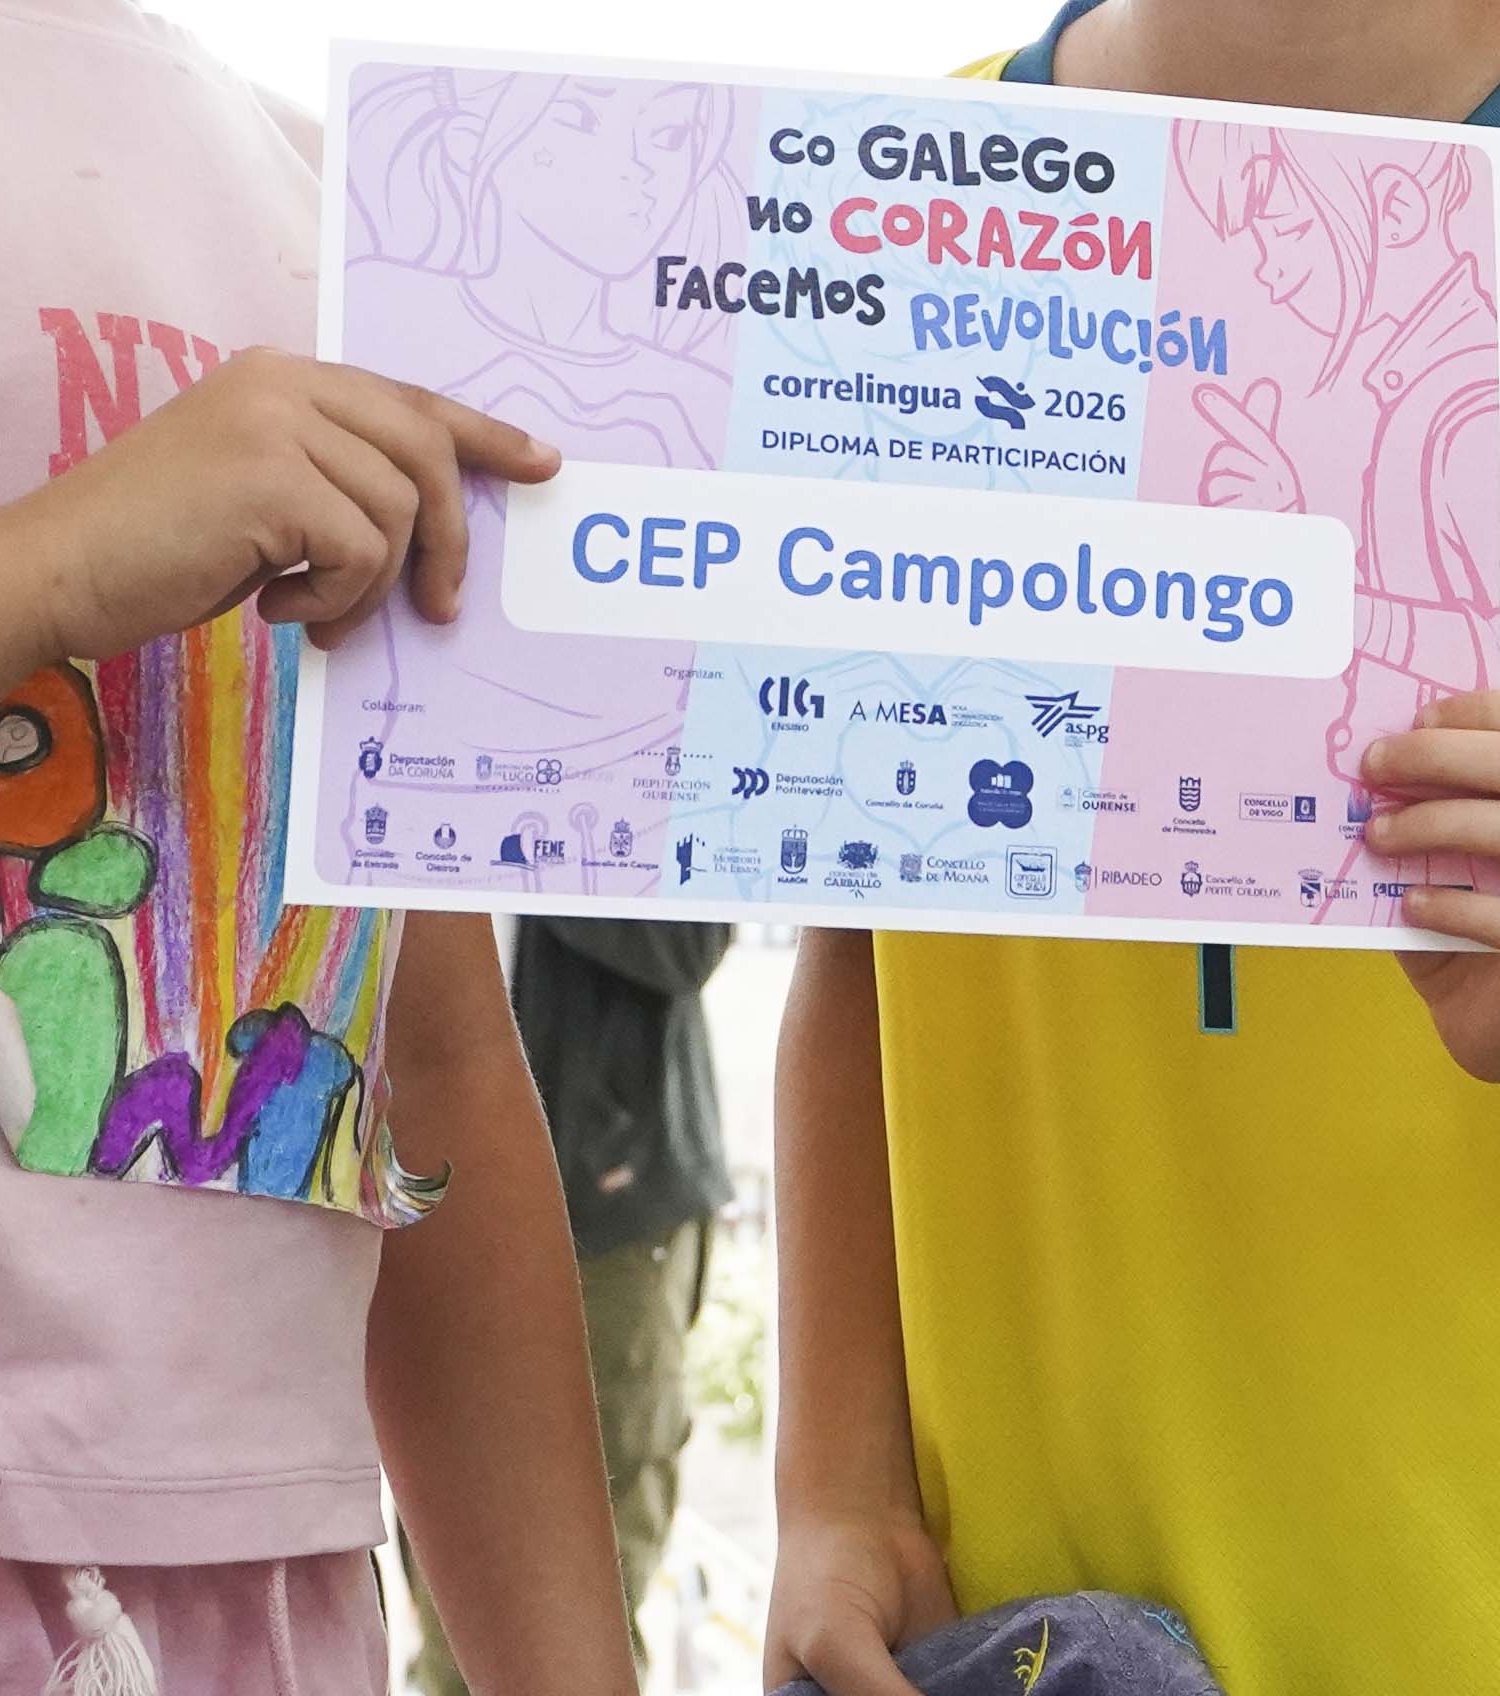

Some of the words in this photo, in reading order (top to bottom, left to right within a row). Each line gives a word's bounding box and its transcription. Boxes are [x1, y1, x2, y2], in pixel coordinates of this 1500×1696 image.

[830, 197, 1152, 280] CORAZÓN
[763, 372, 962, 416] correlingua
[1044, 388, 1127, 423] 2026
[761, 429, 880, 459] DIPLOMA
[889, 439, 924, 462] DE
[931, 442, 1127, 476] PARTICIPACIÓN
[572, 513, 743, 589] CEP
[778, 526, 1295, 645] Campolongo
[663, 666, 724, 681] Organizan:
[361, 699, 426, 714] Colaboran:
[849, 700, 867, 722] A
[875, 701, 947, 726] MESA
[771, 722, 809, 732] ENSINO
[389, 753, 456, 767] Deputación
[388, 765, 405, 777] DA
[407, 766, 455, 779] CORUÑA
[632, 775, 711, 791] DEPUTACIÓN
[775, 772, 844, 788] Deputación
[642, 790, 700, 803] OURENSE
[775, 785, 843, 798] Pontevedra
[1082, 799, 1137, 812] OURENSE
[1243, 798, 1290, 808] CONCELLO
[534, 839, 566, 858] FENE
[926, 855, 986, 872] CONCELLO
[823, 877, 882, 889] CARBALLO
[1101, 870, 1163, 887] RIBADEO
[1324, 886, 1358, 900] Lalín
